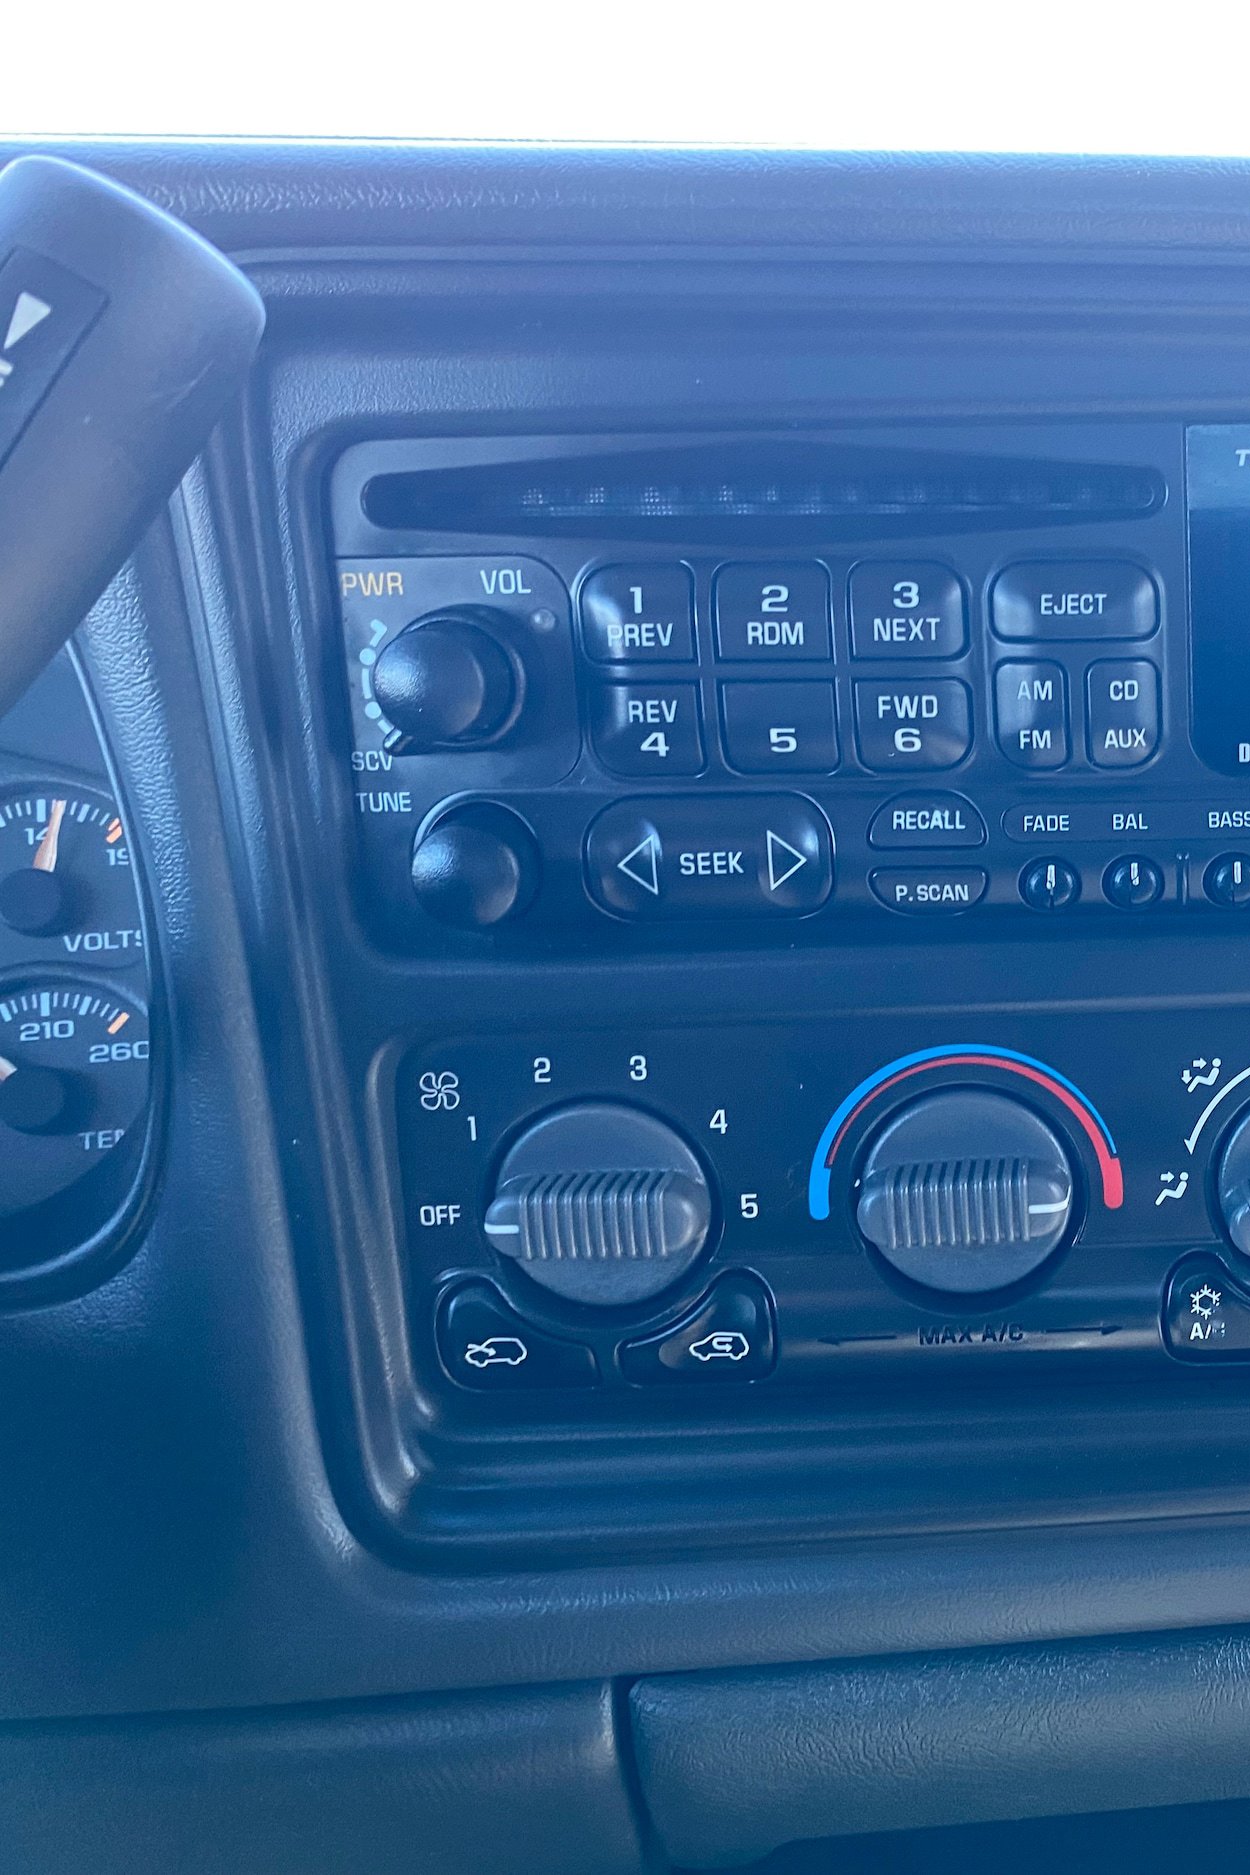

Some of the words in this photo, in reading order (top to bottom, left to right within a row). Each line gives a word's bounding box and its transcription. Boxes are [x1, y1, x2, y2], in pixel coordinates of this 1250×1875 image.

[341, 572, 404, 596] PWR
[480, 569, 532, 595] VOL
[631, 586, 643, 614] 1
[761, 585, 789, 612] 2
[893, 581, 920, 609] 3
[1040, 593, 1107, 615] EJECT
[606, 622, 673, 648] PREV
[747, 621, 804, 645] RDM
[873, 617, 941, 642] NEXT
[1017, 680, 1053, 703] AM
[1109, 679, 1139, 701] CD
[627, 699, 677, 723] REV
[877, 695, 938, 719] FWD
[640, 732, 670, 757] 4
[769, 727, 797, 753] 5
[894, 727, 922, 754] 6
[1019, 729, 1052, 749] FM
[1104, 728, 1146, 749] AUX
[351, 750, 393, 771] SCV
[355, 791, 412, 813] TUNE
[892, 809, 966, 830] RECALL
[1023, 814, 1070, 832] FADE
[1112, 813, 1148, 830] BAL
[679, 851, 744, 875] SEEK
[895, 884, 969, 902] P.SCAN
[19, 1019, 75, 1041] 210
[88, 1040, 149, 1063] 260
[533, 1057, 551, 1083] 2
[629, 1055, 647, 1081] 3
[467, 1115, 477, 1141] 1
[709, 1109, 728, 1135] 4
[419, 1204, 461, 1226] OFF
[740, 1193, 759, 1219] 5
[918, 1325, 973, 1346] MAX
[981, 1321, 1025, 1343] A/C
